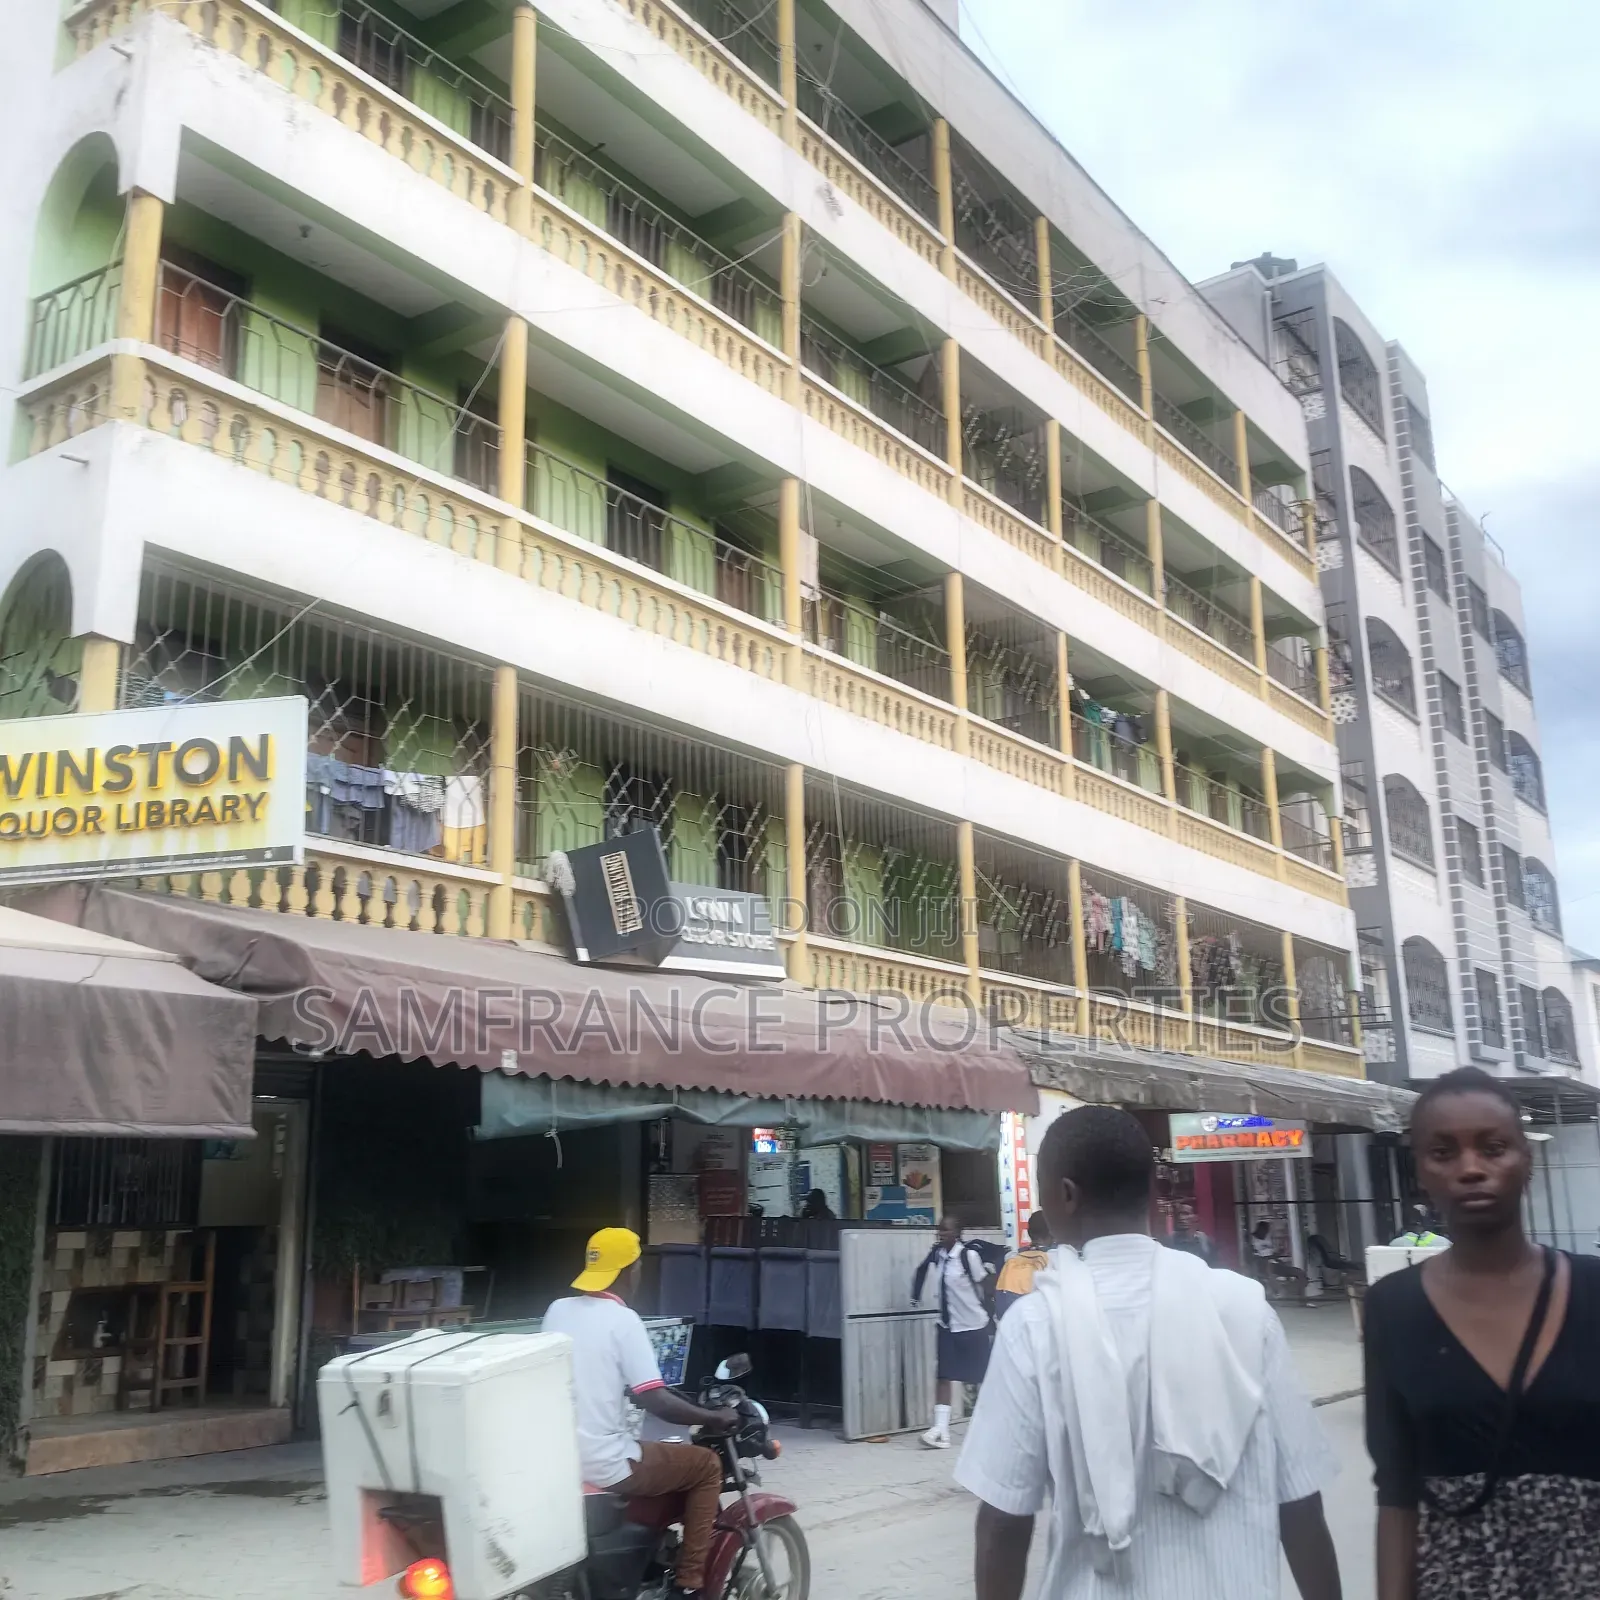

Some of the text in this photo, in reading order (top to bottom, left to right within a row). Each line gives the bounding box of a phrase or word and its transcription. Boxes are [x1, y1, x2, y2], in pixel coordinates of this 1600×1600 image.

[116, 791, 269, 832] LIBRARY
[604, 853, 632, 903] WALKING
[1176, 1129, 1303, 1150] PHARMACY
